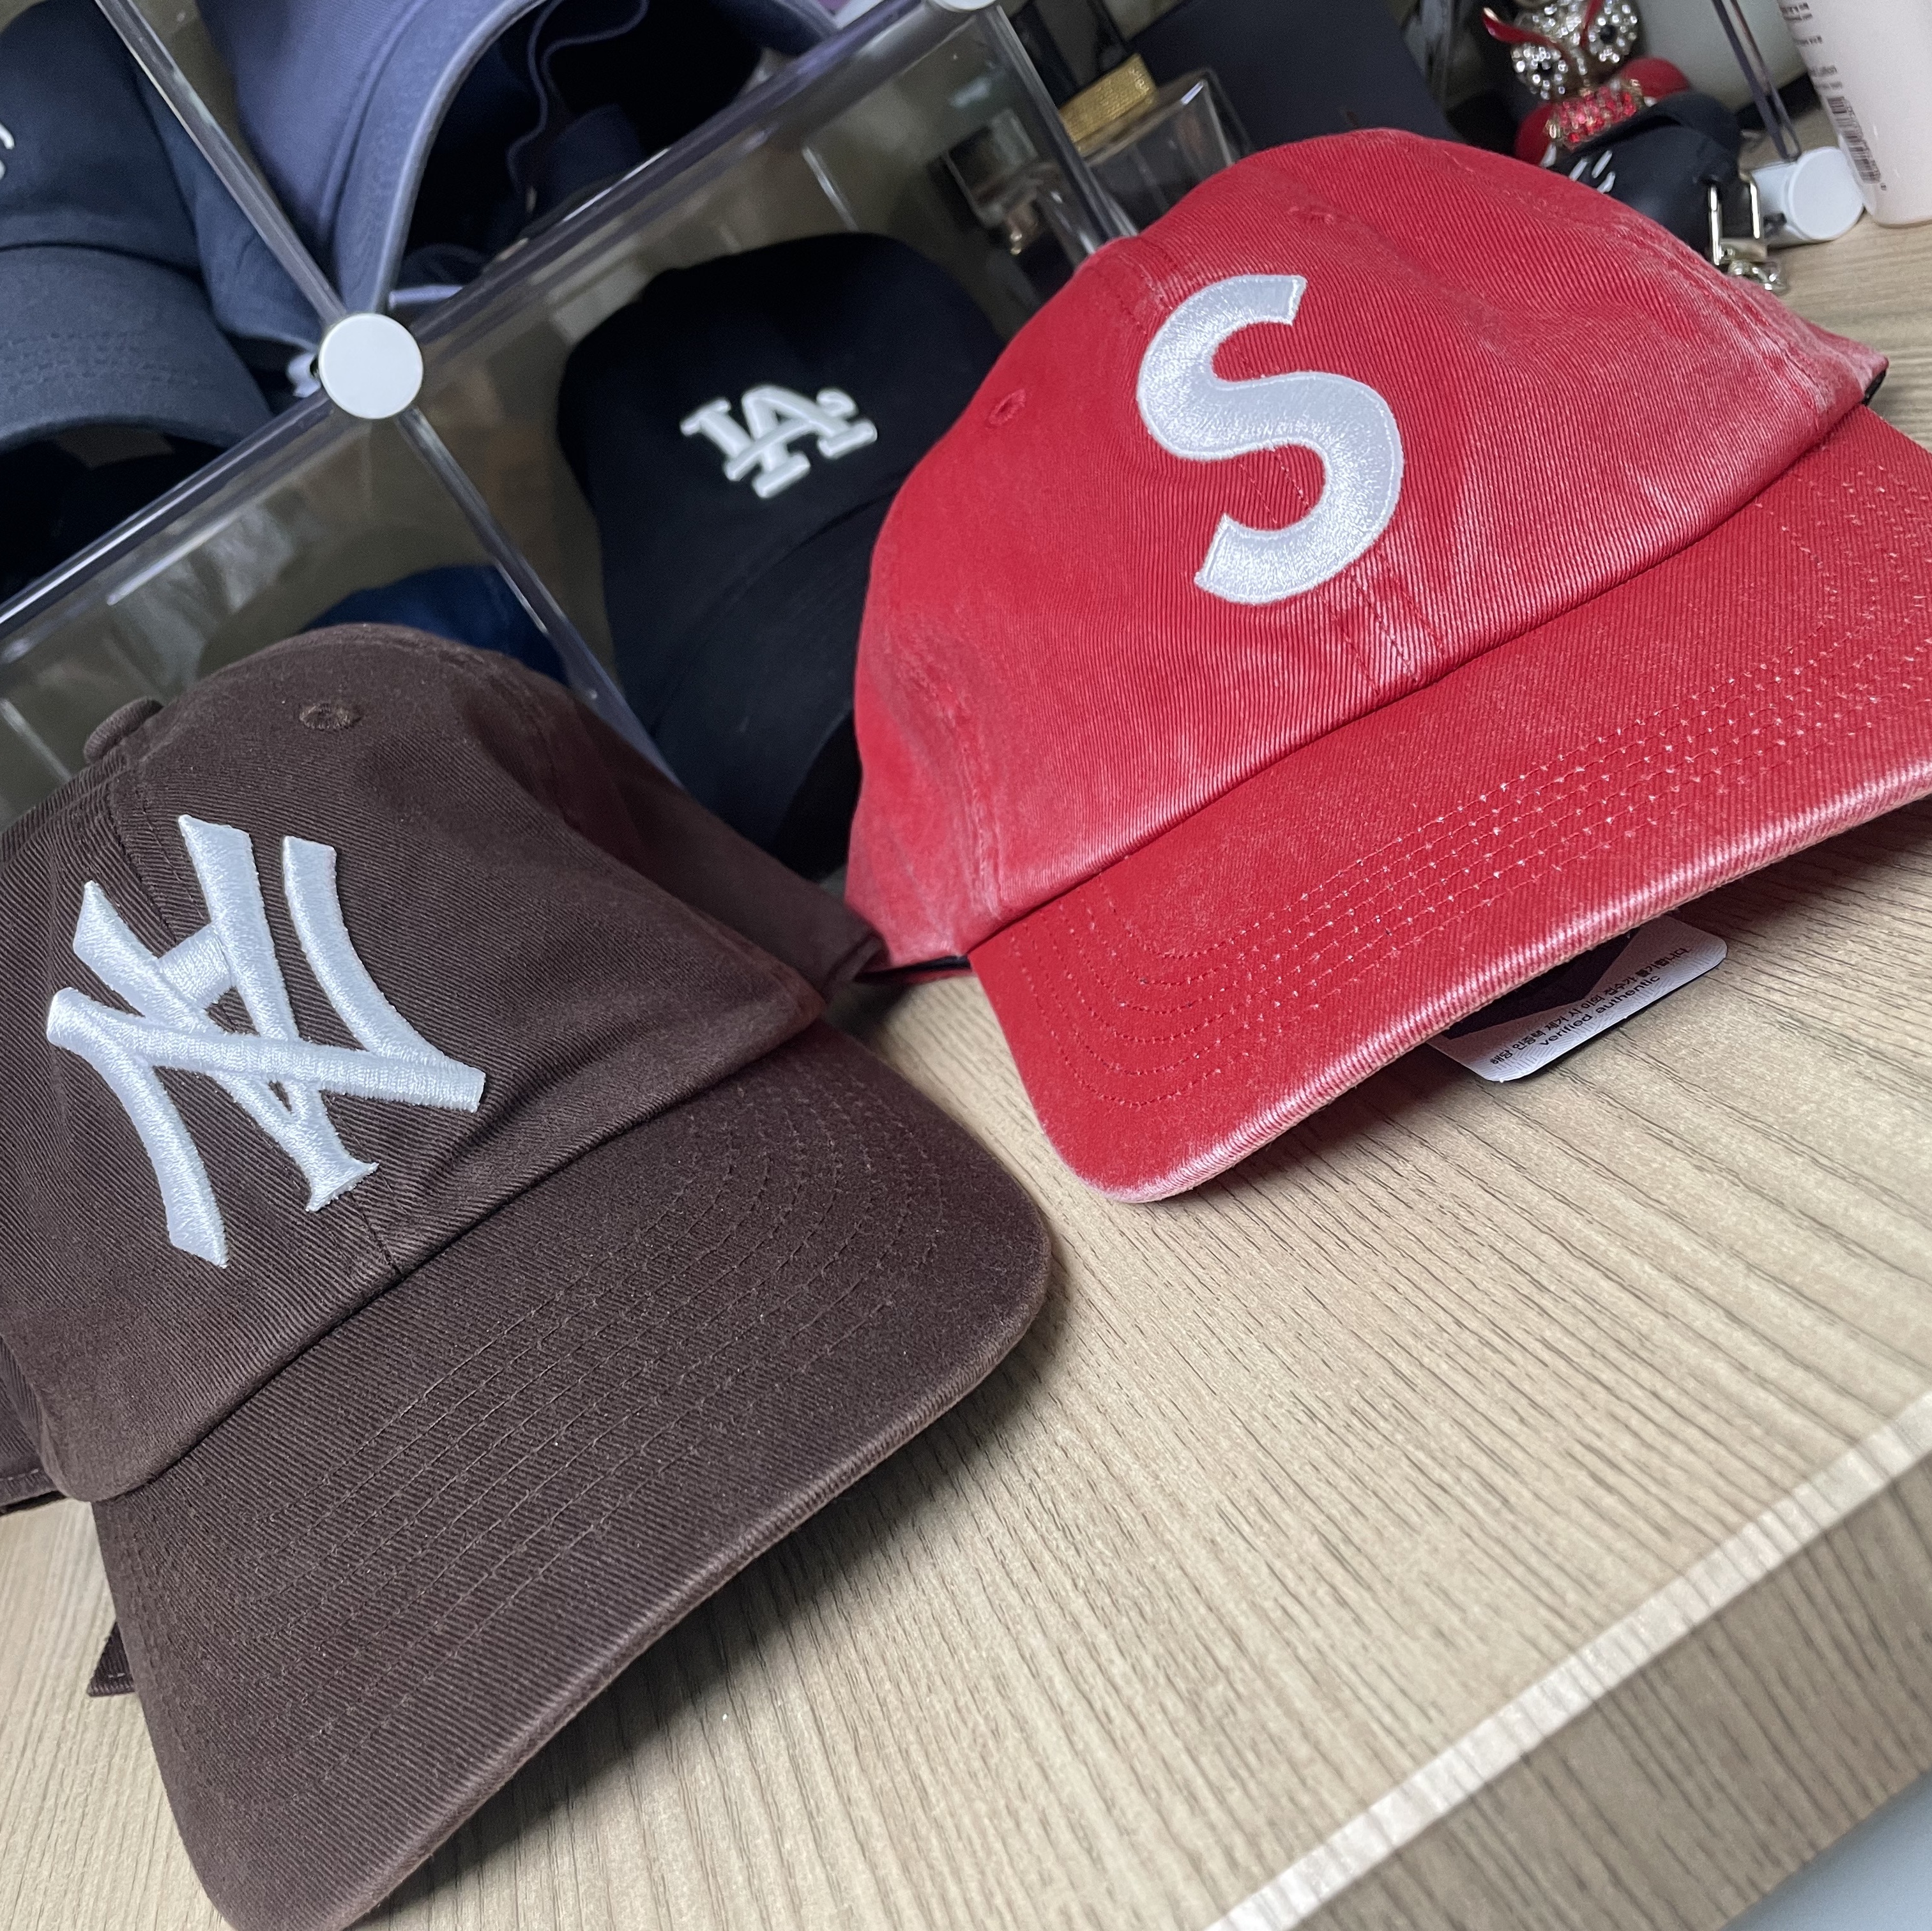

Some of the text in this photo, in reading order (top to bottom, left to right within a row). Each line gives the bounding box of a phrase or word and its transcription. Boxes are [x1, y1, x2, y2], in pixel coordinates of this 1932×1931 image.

[680, 386, 878, 499] LA
[1136, 273, 1404, 605] S
[47, 814, 486, 1268] NY
[1489, 1049, 1513, 1064] 해당
[1544, 1015, 1569, 1031] 제거
[1569, 1008, 1583, 1017] 시
[1581, 994, 1606, 1009] 이의
[1539, 976, 1661, 1045] verified authentic
